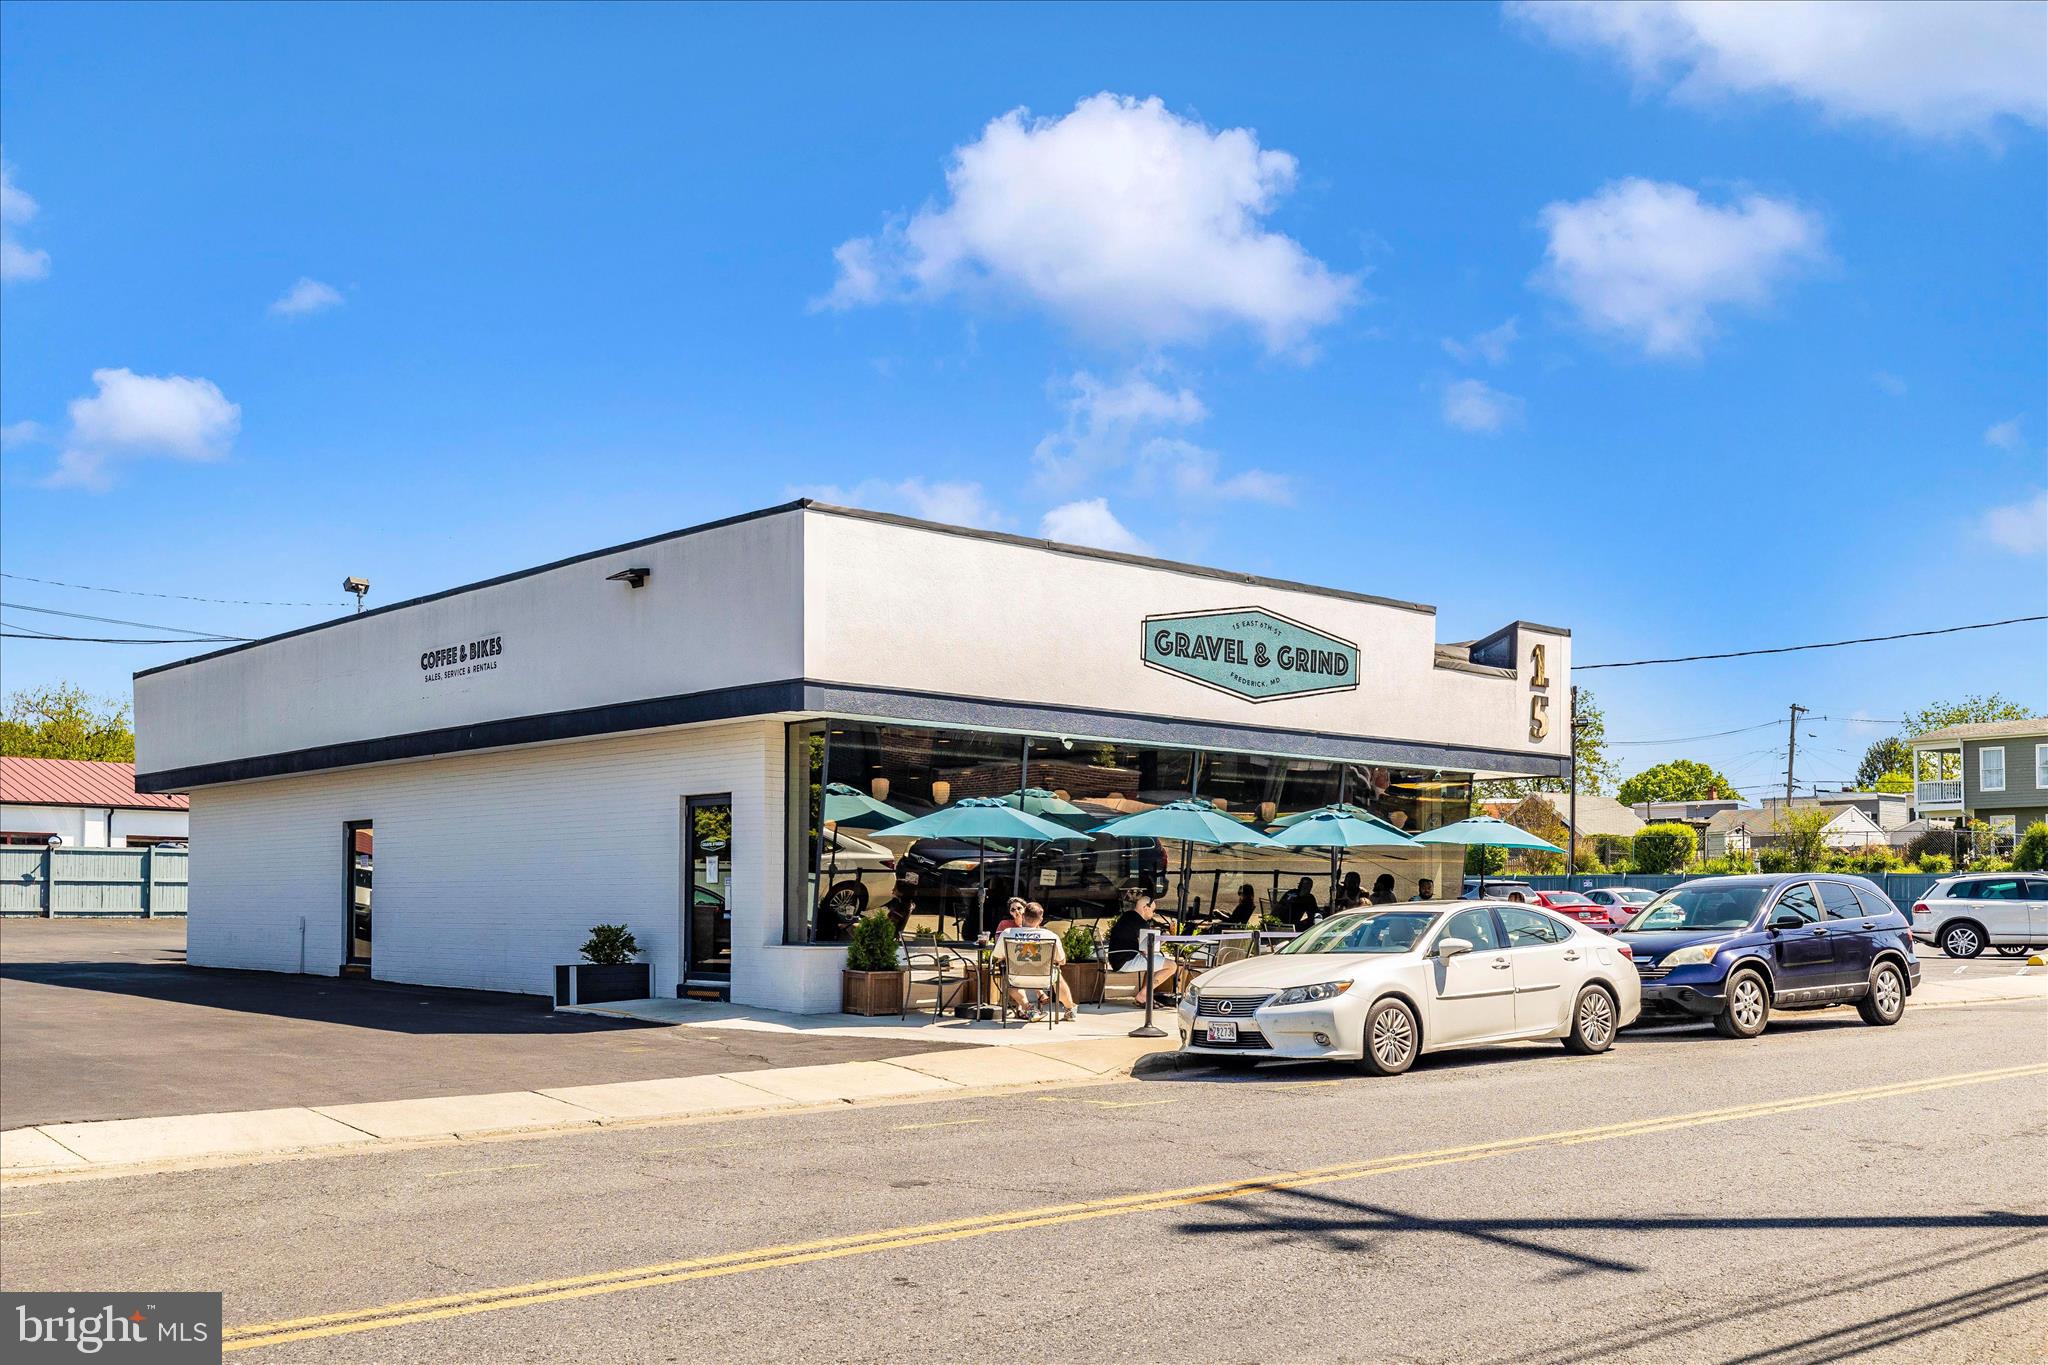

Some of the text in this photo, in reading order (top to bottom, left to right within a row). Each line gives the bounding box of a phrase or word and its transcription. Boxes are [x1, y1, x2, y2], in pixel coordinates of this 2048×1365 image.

[1232, 622, 1240, 631] 15
[1260, 622, 1273, 631] 6TH
[1274, 628, 1282, 637] ST
[421, 637, 502, 670] COFFEE & BIKES
[1154, 630, 1349, 676] GRAVEL & GRIND
[424, 661, 497, 683] SALES, SERVICE & RENTALS
[1270, 677, 1281, 686] MD
